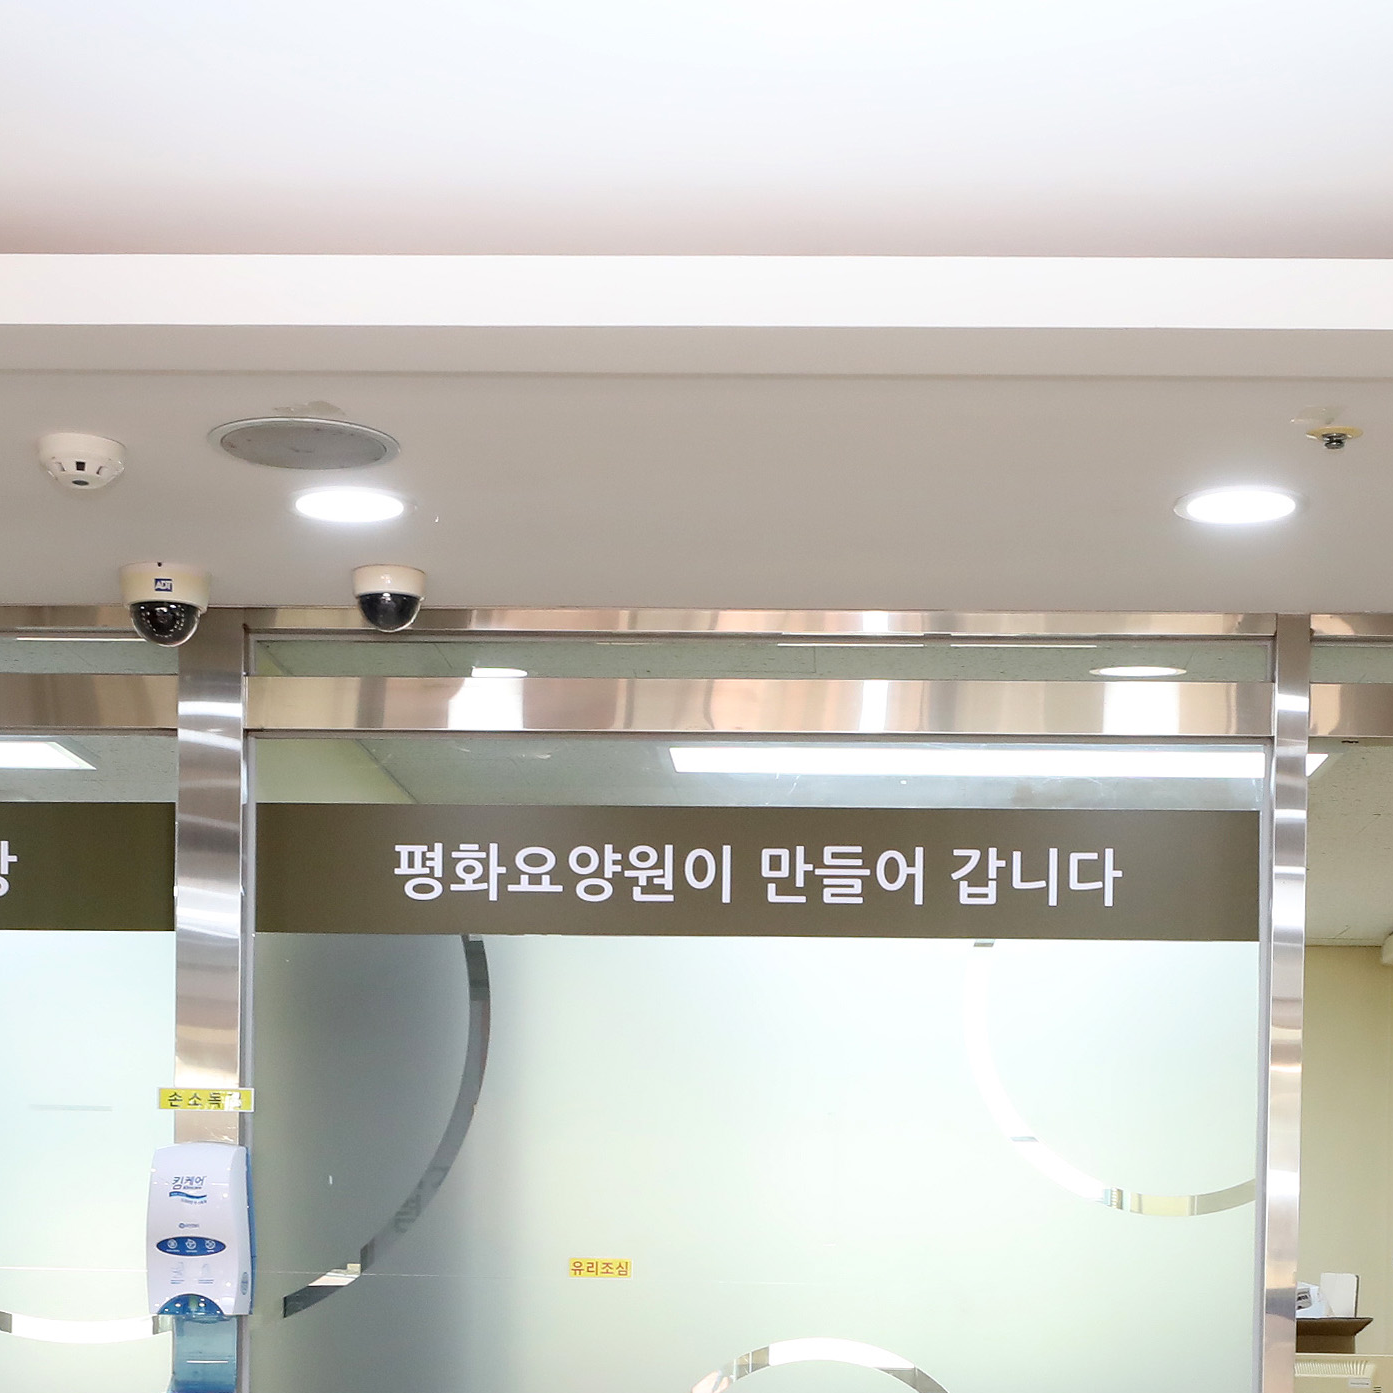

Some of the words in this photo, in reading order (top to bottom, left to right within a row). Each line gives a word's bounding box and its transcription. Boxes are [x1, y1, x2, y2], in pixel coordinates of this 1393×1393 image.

[155, 579, 172, 590] ADT
[393, 842, 731, 904] 평화요양원이
[761, 845, 924, 906] 만들어
[951, 846, 1123, 907] 갑니다
[570, 1260, 629, 1276] 유리조심
